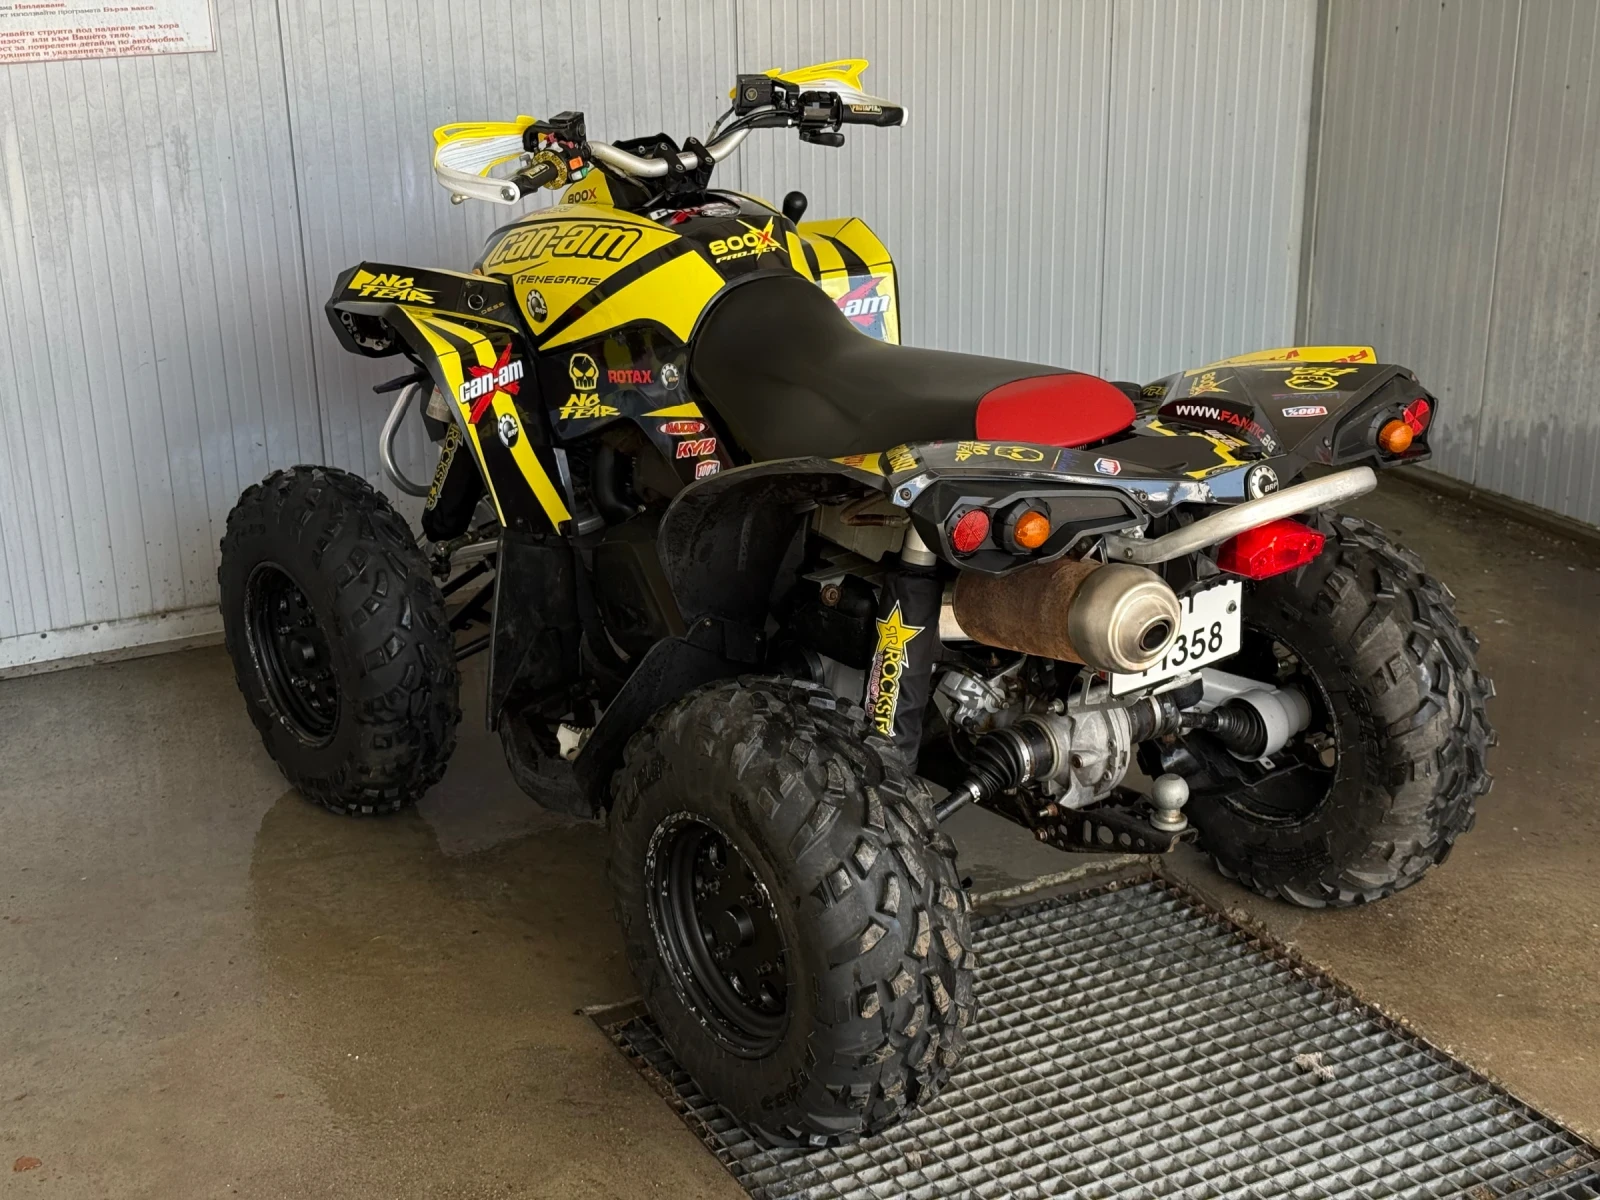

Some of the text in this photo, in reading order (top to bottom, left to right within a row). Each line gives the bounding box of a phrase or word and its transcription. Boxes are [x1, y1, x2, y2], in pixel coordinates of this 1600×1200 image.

[567, 187, 598, 205] 800X
[488, 225, 642, 266] can-am
[709, 229, 774, 256] 800X
[371, 273, 414, 288] NO
[516, 275, 601, 286] RENEGADE
[358, 285, 436, 304] FEAR
[459, 359, 525, 403] can-am
[608, 369, 652, 384] ROTAX
[565, 392, 600, 407] NO
[559, 405, 622, 420] FEAR
[1176, 404, 1277, 454] WWW.FANATIC.BG
[676, 437, 717, 459] KYB
[1264, 481, 1278, 493] BRP
[1142, 621, 1223, 678] 358
